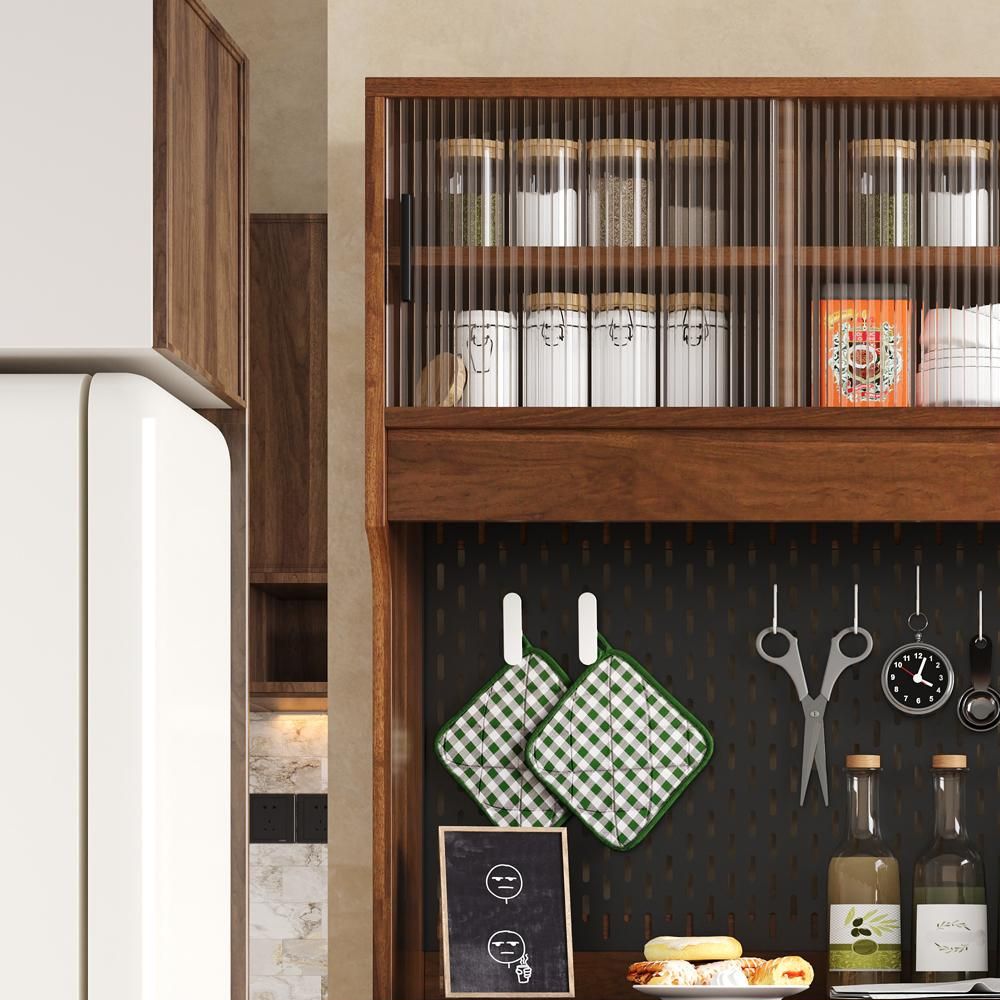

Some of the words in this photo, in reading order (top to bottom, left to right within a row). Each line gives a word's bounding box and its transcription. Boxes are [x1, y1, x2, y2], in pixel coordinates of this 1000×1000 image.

[903, 654, 911, 662] 11
[914, 652, 923, 660] 12
[893, 661, 903, 669] 10
[890, 673, 896, 681] 9
[893, 685, 899, 693] 8
